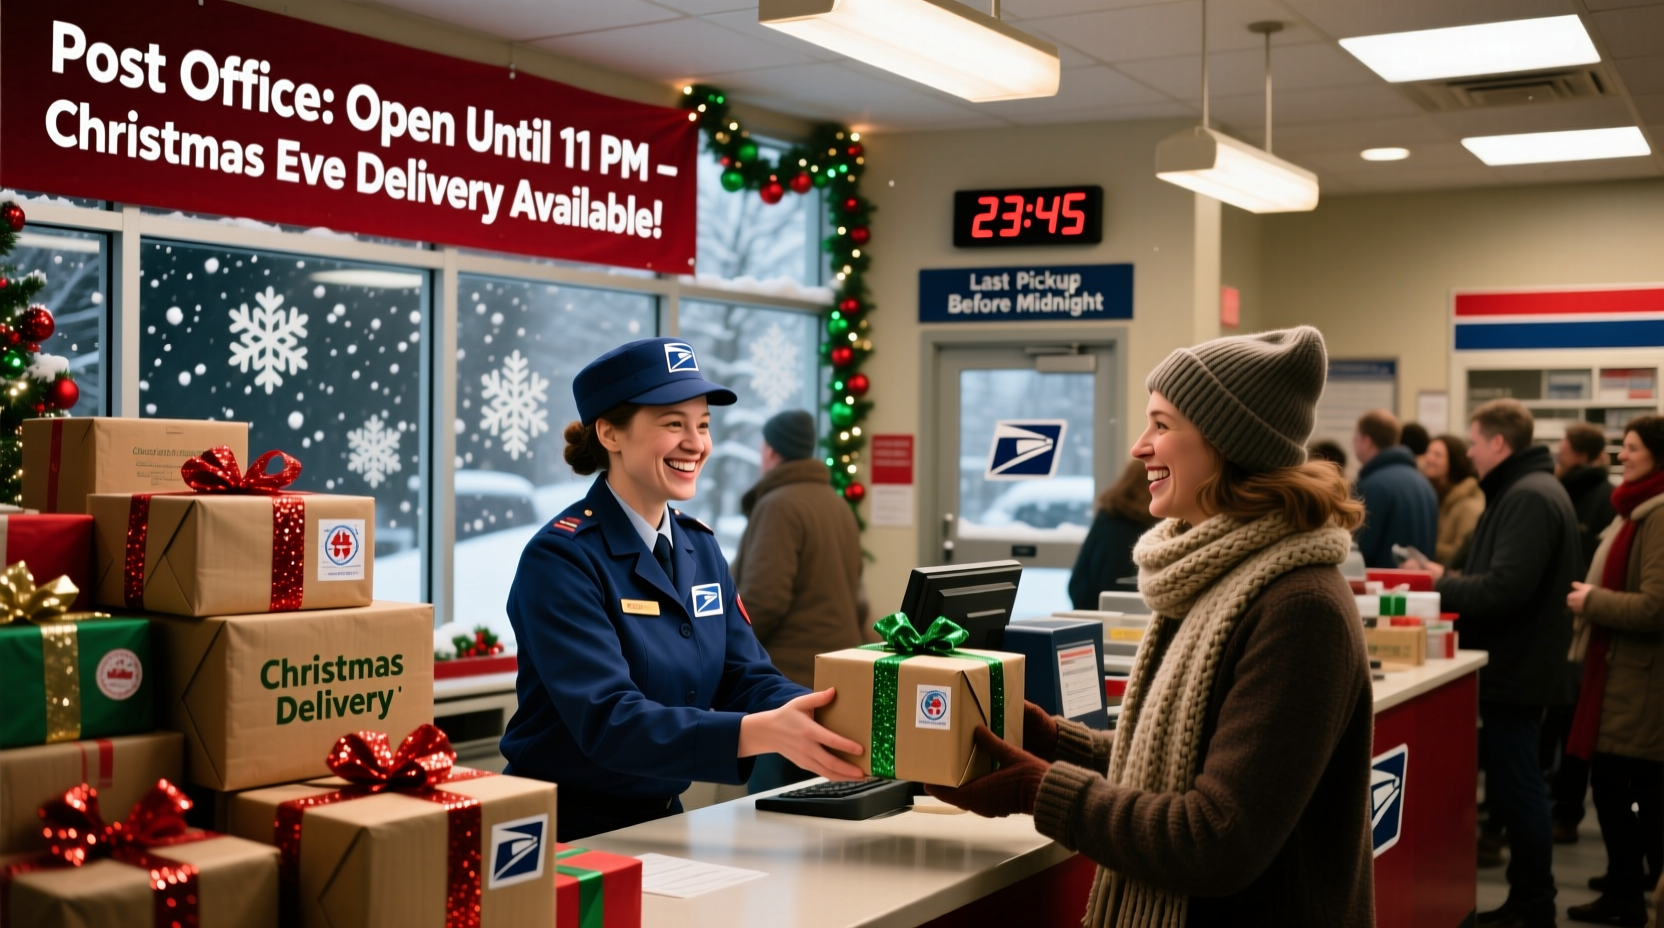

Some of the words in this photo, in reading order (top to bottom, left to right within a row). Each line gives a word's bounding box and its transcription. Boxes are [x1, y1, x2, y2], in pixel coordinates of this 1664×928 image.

[52, 20, 167, 94] Post
[180, 50, 335, 125] Office:
[347, 84, 456, 148] Open
[467, 106, 552, 165] Until
[560, 127, 591, 172] 11
[600, 135, 649, 182] PM
[45, 99, 265, 178] Christmas
[277, 139, 347, 190] Eve
[356, 152, 505, 225] Delivery
[509, 179, 663, 239] Available!
[971, 192, 1086, 239] 23:45
[969, 273, 1010, 292] Last
[1016, 270, 1082, 294] Pickup
[947, 293, 1012, 314] Before
[1016, 291, 1104, 317] Midnight
[259, 653, 404, 691] Christmas
